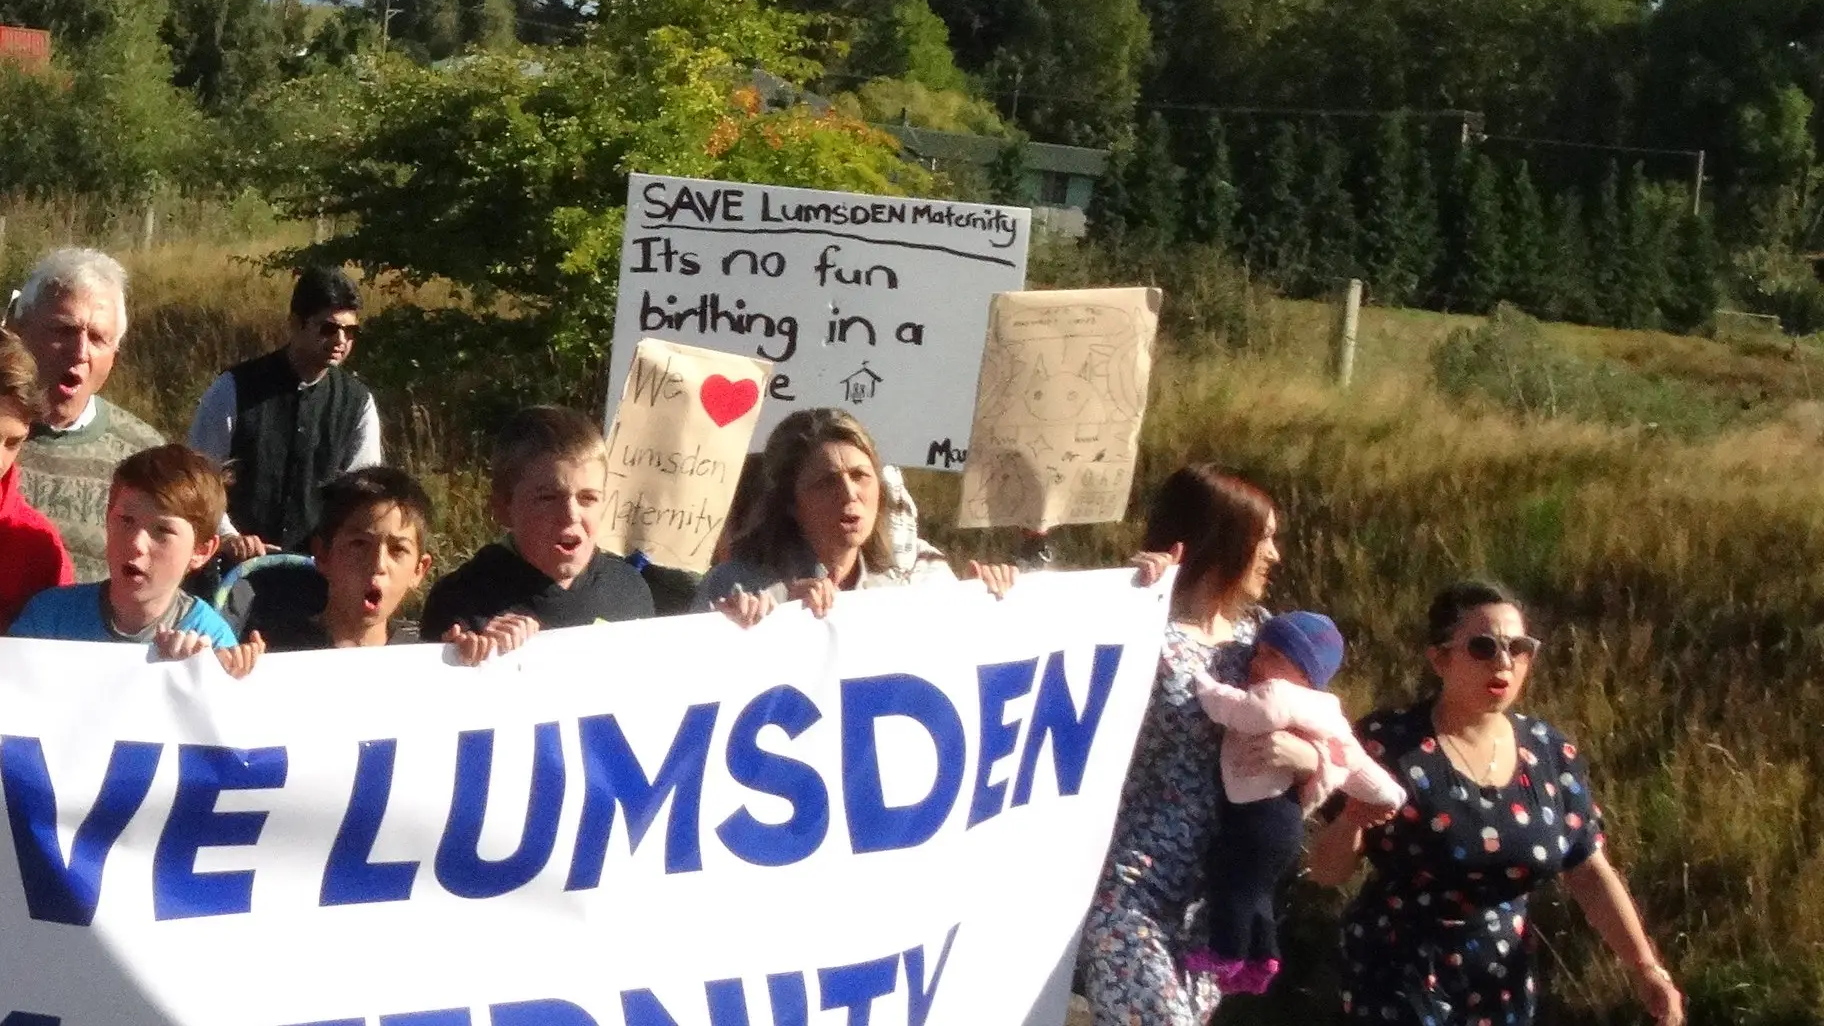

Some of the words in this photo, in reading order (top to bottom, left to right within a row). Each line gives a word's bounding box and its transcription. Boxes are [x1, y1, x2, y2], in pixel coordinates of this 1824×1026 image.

[642, 181, 745, 223] SAVE
[911, 203, 1018, 249] Maternity
[629, 236, 702, 276] Its
[721, 248, 788, 278] no
[814, 244, 900, 290] fun
[639, 289, 799, 363] birthing
[826, 306, 877, 347] in
[894, 320, 926, 346] a
[633, 356, 686, 407] We
[606, 422, 727, 484] Lumsden
[318, 643, 1125, 907] LUMSDEN
